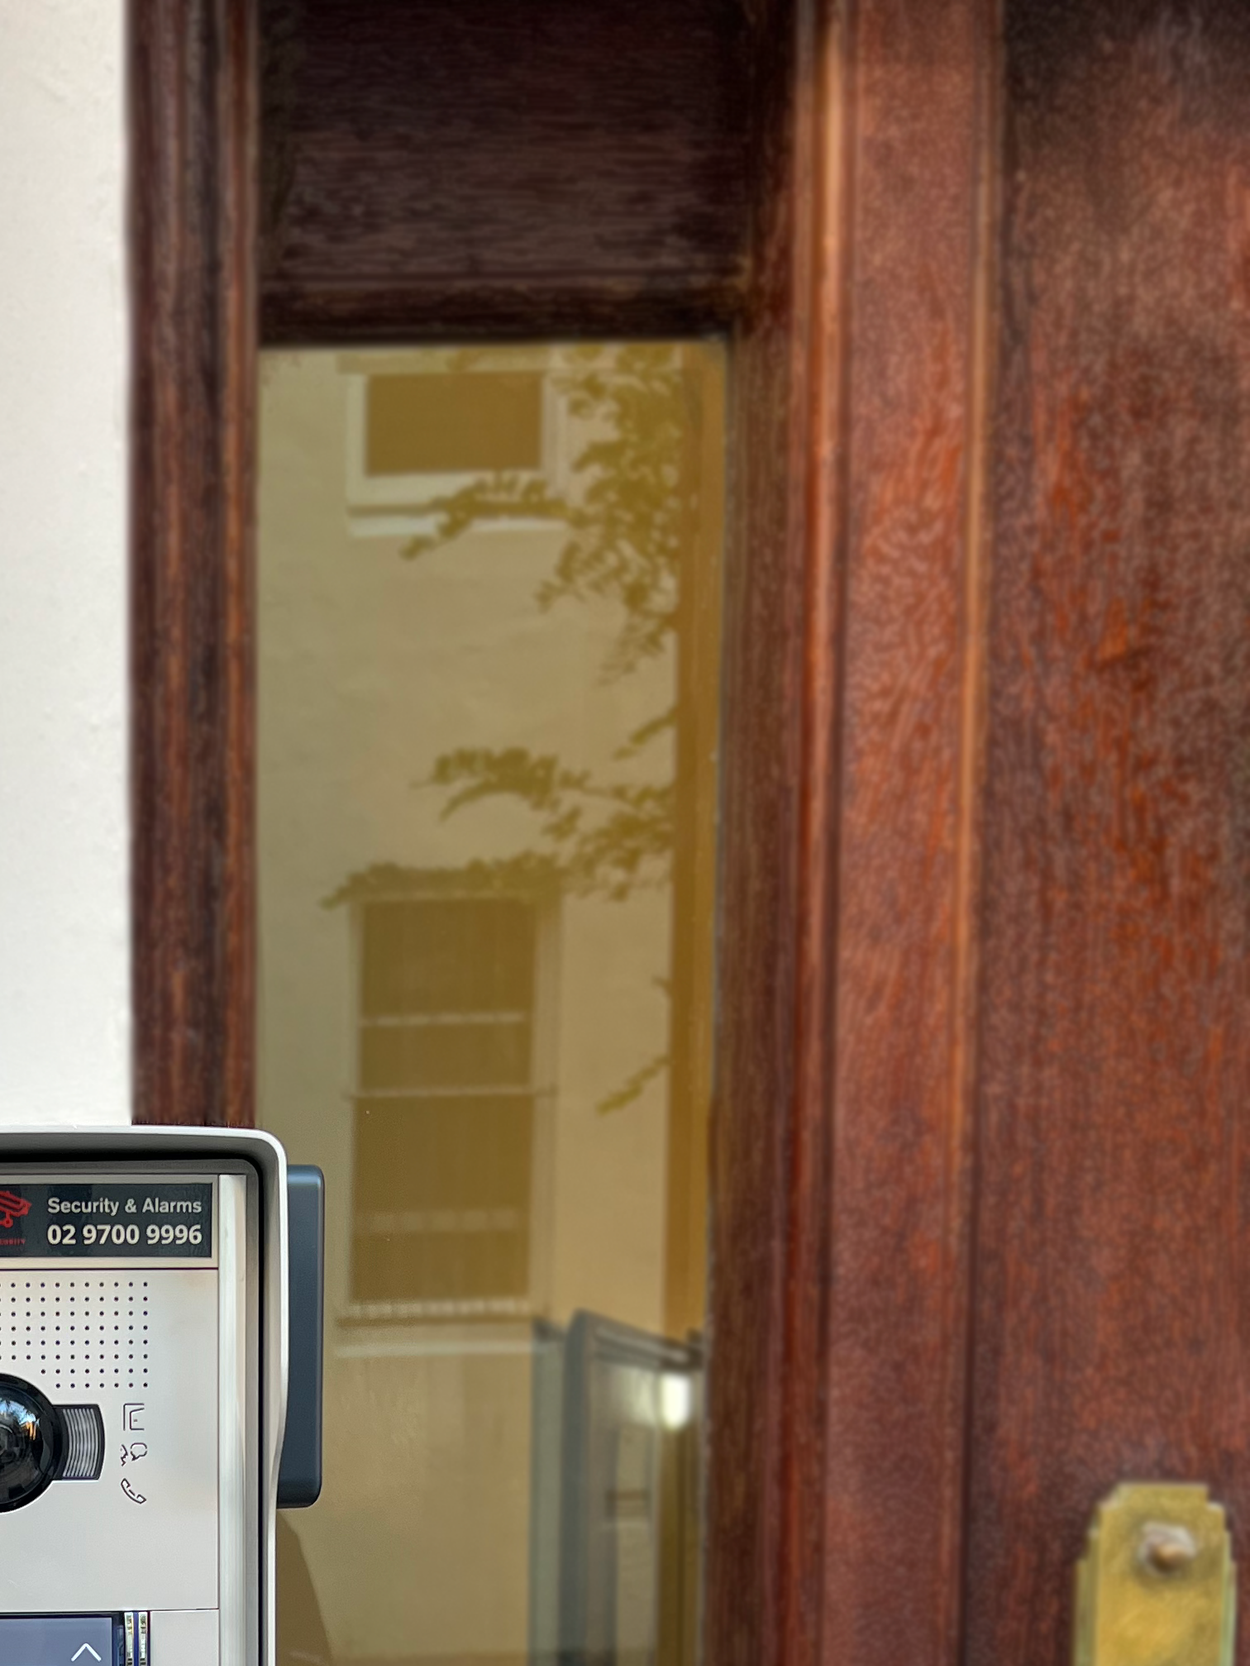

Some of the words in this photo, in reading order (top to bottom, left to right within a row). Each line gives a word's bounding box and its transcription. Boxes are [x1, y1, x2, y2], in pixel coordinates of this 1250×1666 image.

[47, 1197, 120, 1217] Security
[124, 1198, 137, 1213] &
[142, 1197, 202, 1213] Alarms
[47, 1224, 77, 1245] 02
[82, 1224, 140, 1245] 9700
[146, 1224, 203, 1245] 9996
